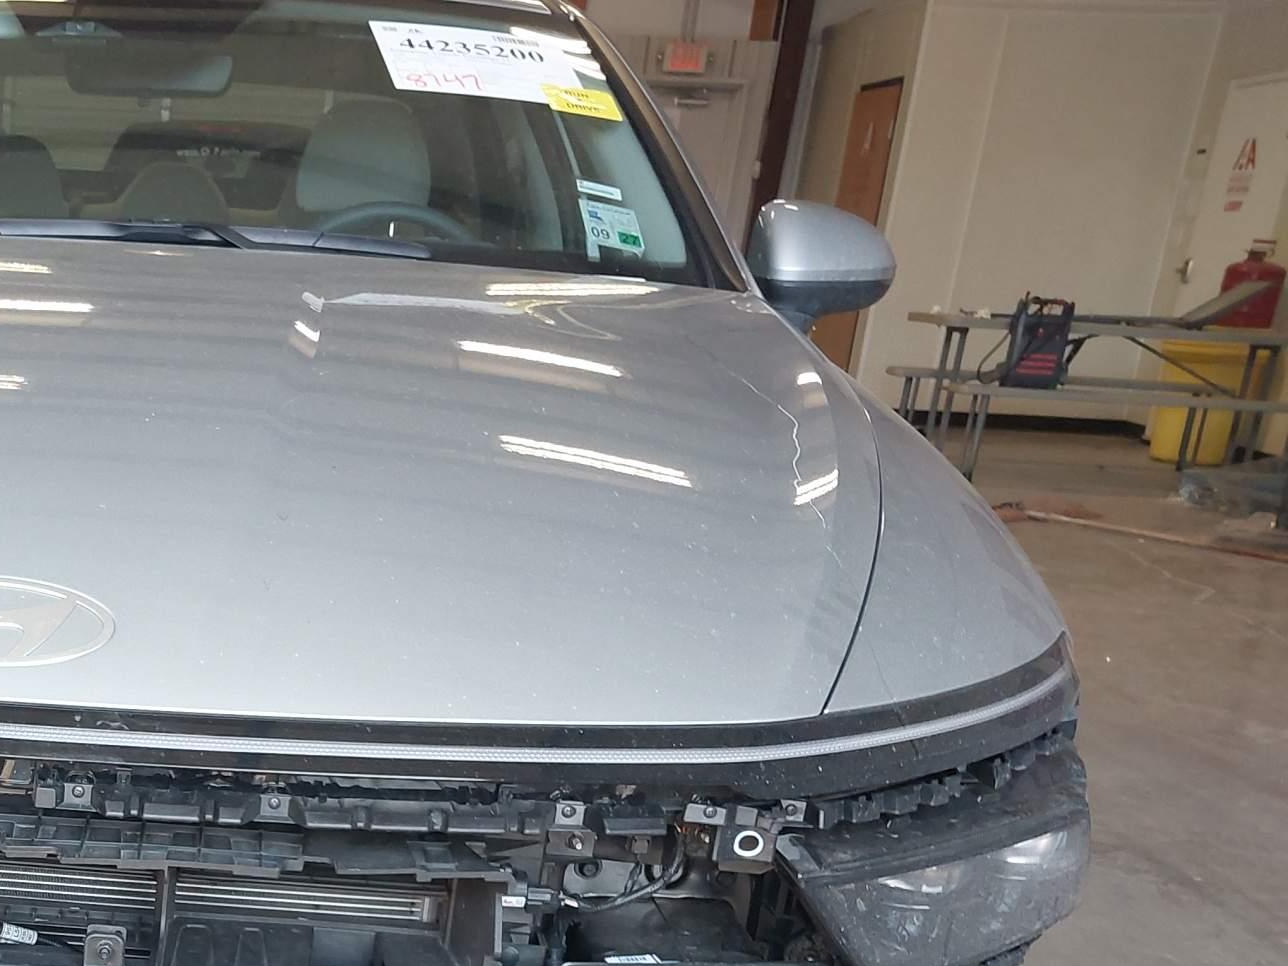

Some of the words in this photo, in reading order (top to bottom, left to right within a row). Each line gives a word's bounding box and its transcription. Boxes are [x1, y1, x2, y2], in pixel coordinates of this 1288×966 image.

[400, 38, 544, 63] 44235200
[406, 73, 483, 91] 8747
[591, 226, 610, 240] 09
[620, 232, 640, 246] 27
